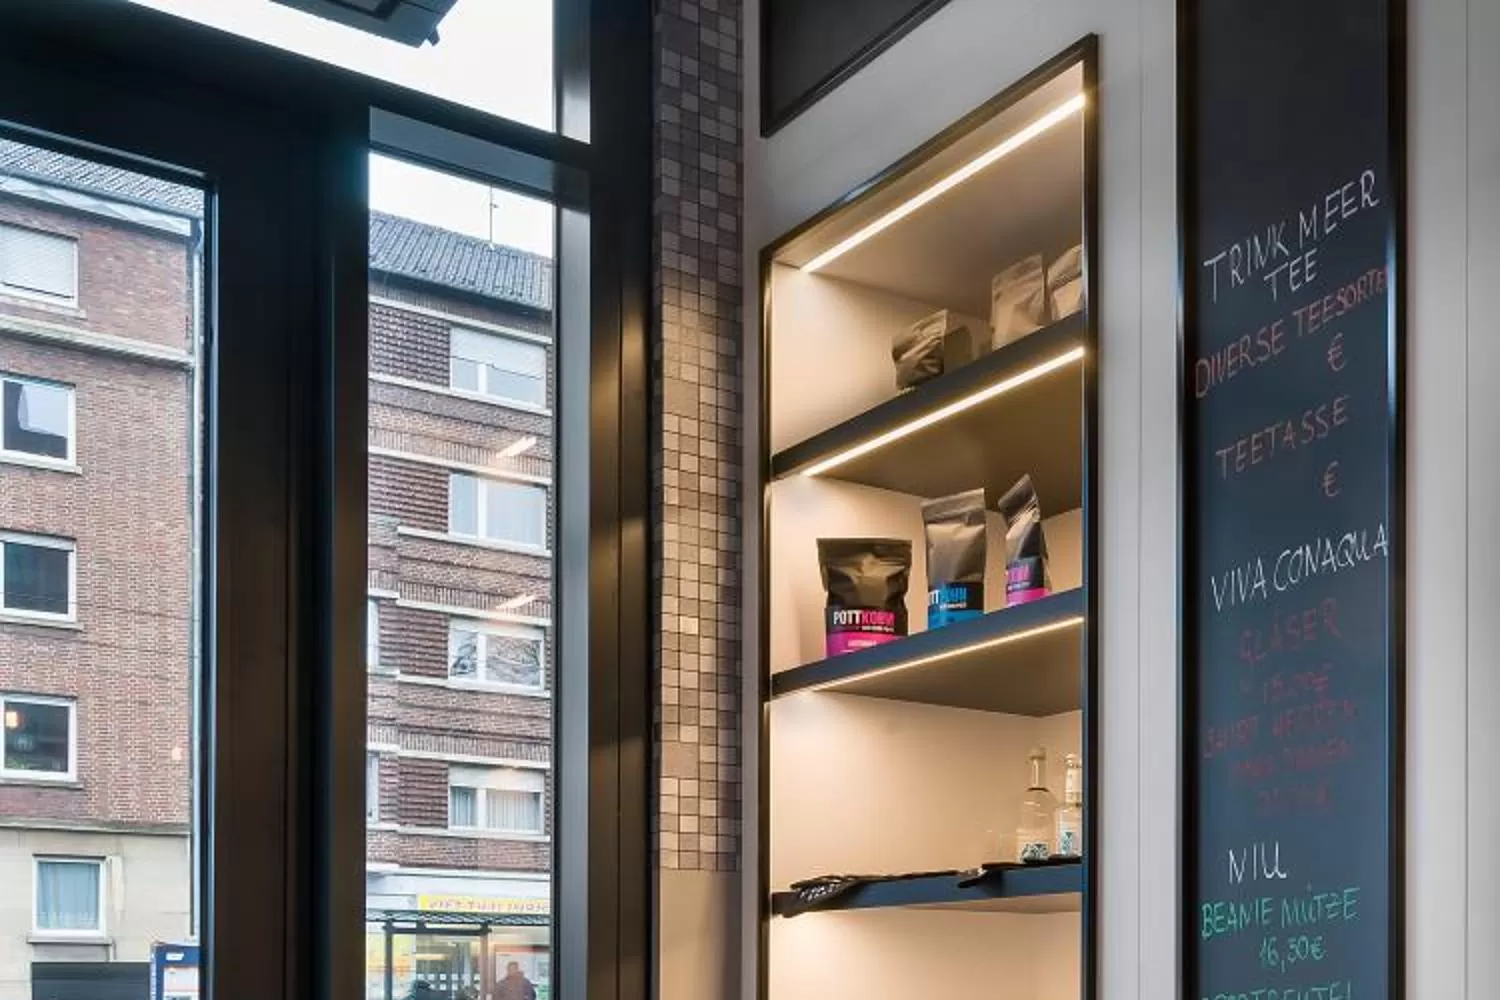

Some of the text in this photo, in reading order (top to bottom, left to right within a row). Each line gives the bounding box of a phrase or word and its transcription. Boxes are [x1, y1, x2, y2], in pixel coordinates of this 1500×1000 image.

[1203, 169, 1381, 304] TRINK MEER
[1263, 248, 1319, 300] TEE
[1195, 266, 1388, 398] DIVERSE TEESORTE
[1327, 332, 1346, 372] €
[1215, 395, 1350, 481] TEETASSE
[1321, 459, 1340, 498] €
[1228, 840, 1288, 885] NIU
[1200, 896, 1274, 940] BEANIE
